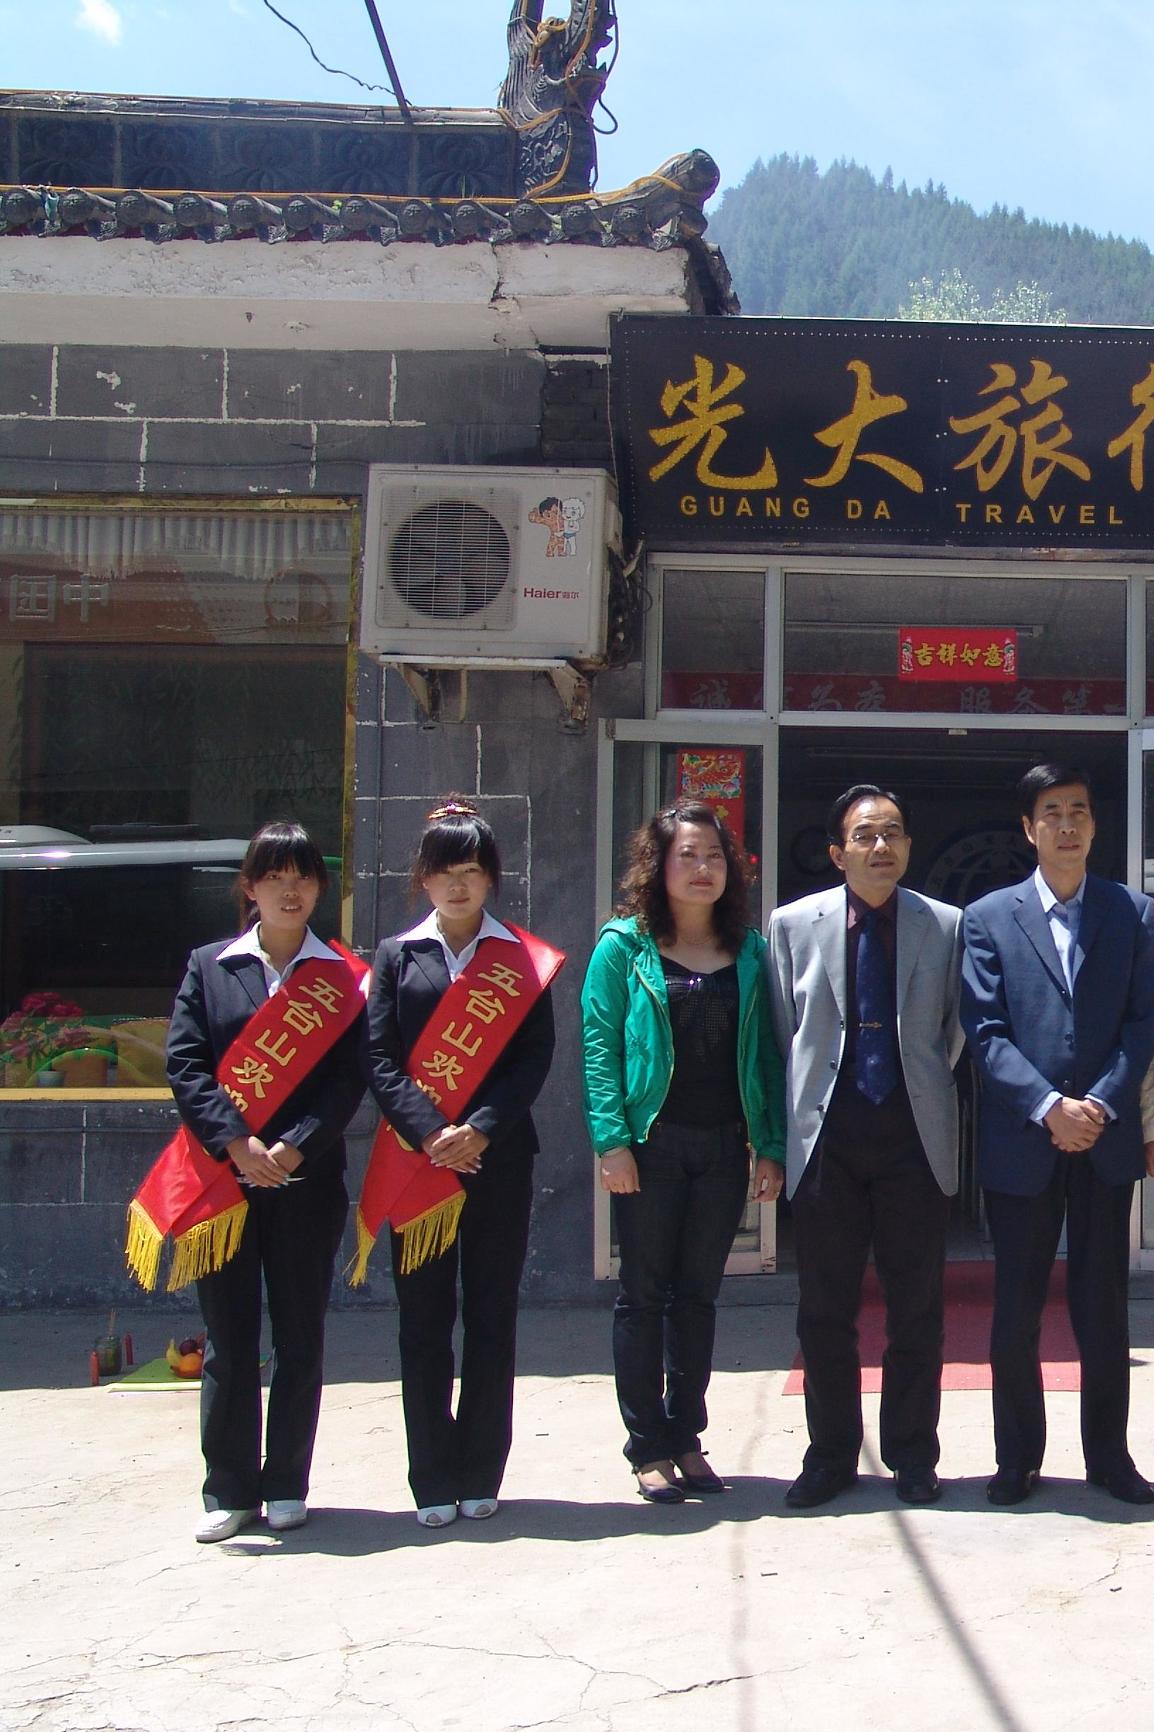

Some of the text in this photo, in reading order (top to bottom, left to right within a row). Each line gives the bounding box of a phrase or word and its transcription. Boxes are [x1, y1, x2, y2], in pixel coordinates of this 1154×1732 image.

[680, 495, 810, 518] GUANG
[847, 499, 892, 520] DA
[956, 503, 1123, 525] TRAVEL
[523, 587, 561, 599] Haier
[914, 642, 1004, 668] 吉祥如意
